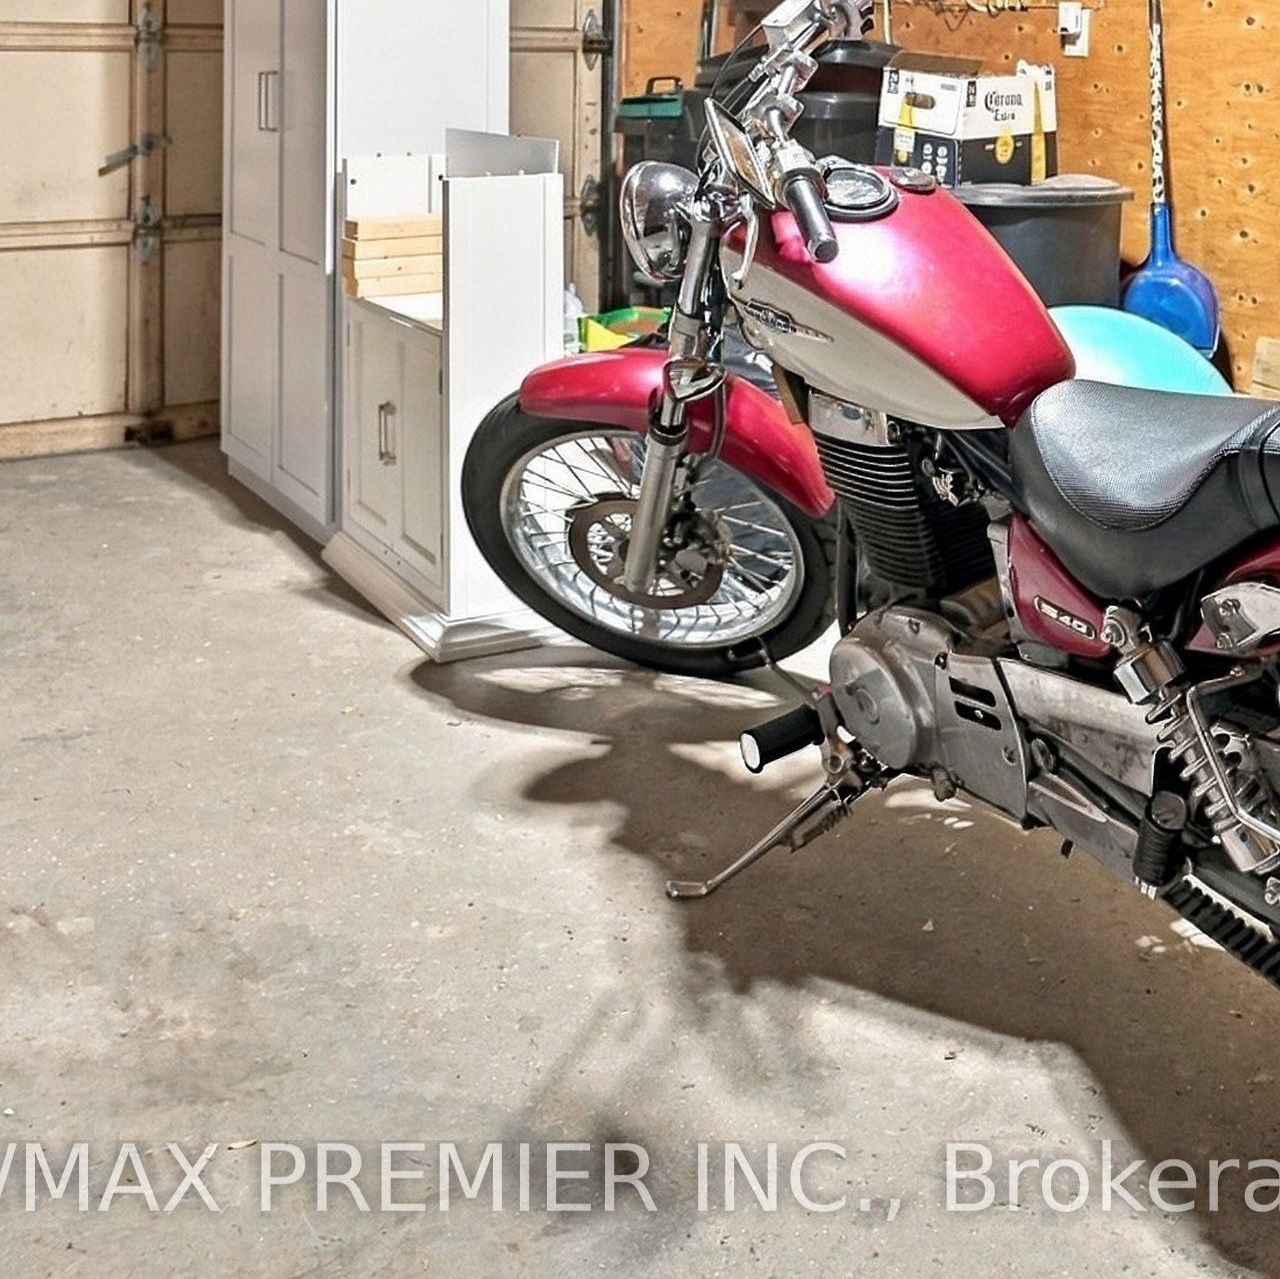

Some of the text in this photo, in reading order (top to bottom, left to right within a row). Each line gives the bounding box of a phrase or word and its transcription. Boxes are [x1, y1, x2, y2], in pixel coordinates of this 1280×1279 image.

[984, 91, 1023, 112] Corona
[993, 109, 1016, 121] Extra
[1041, 602, 1087, 633] S40
